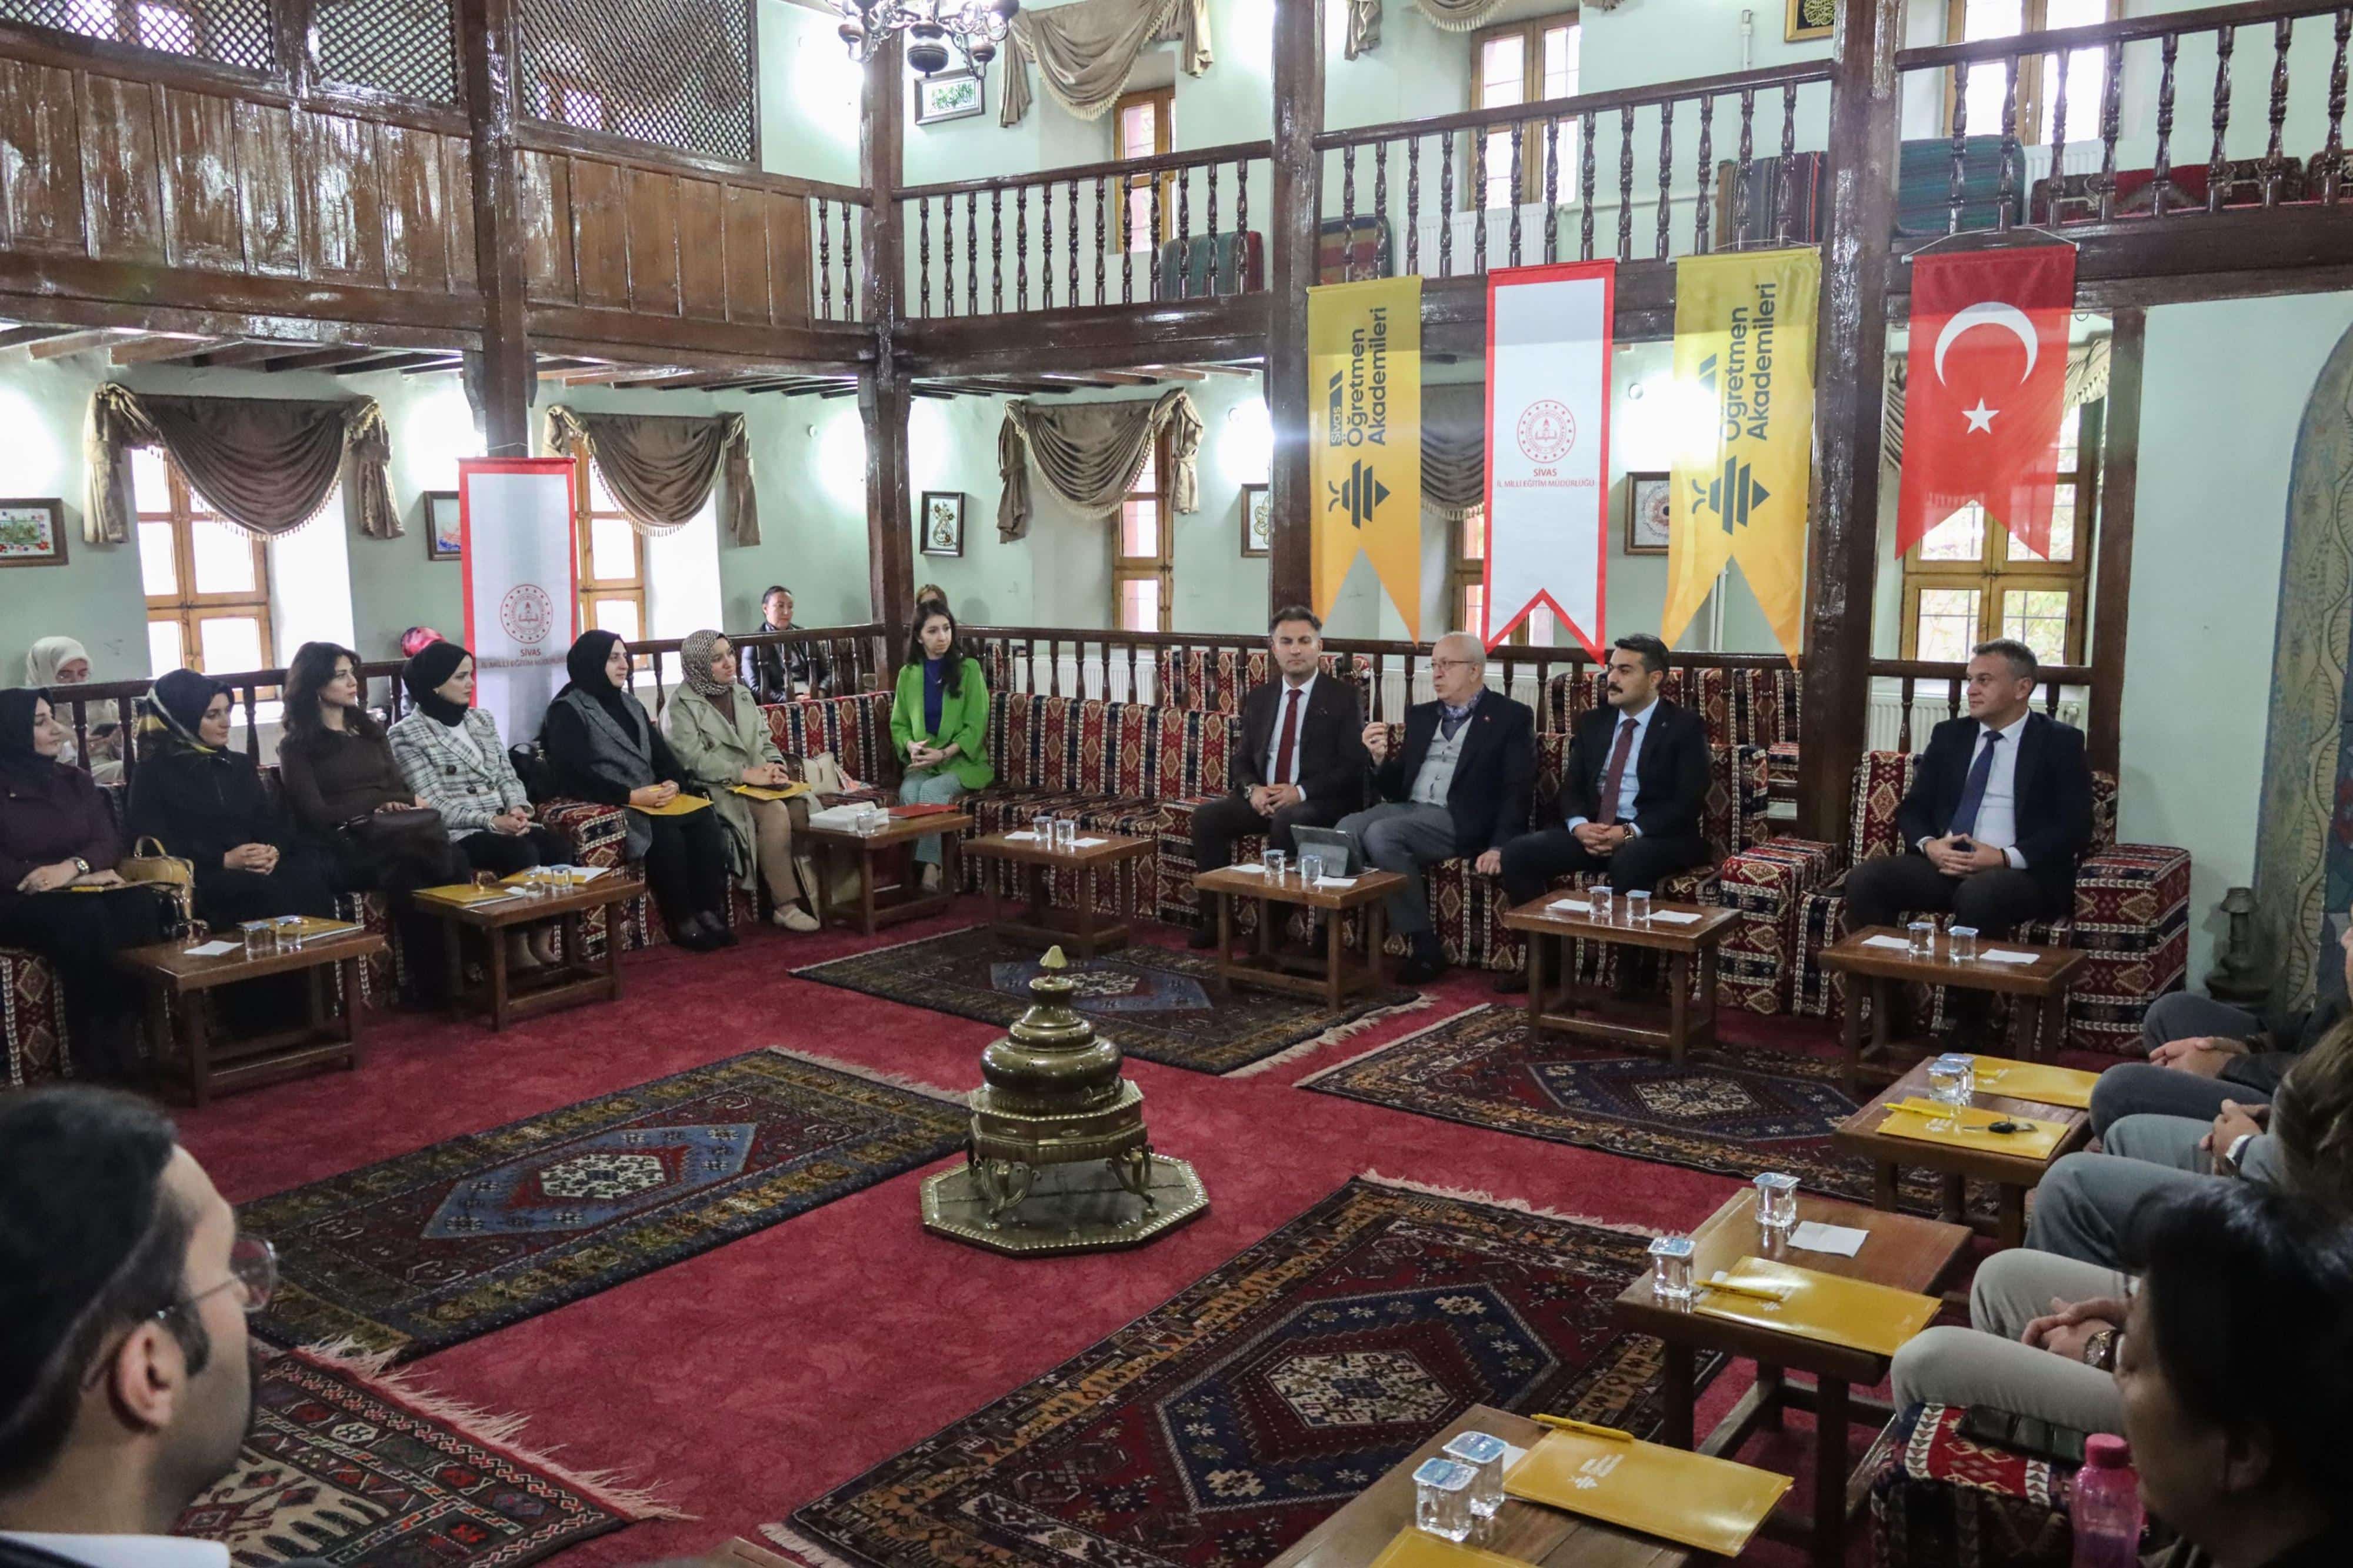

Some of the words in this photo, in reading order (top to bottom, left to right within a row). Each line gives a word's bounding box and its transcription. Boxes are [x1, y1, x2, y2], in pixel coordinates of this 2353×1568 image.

[1368, 307, 1387, 446] Akademileri
[1747, 283, 1777, 441] Akademileri
[1343, 329, 1368, 447] Öğretmen
[1331, 406, 1342, 444] Sivas
[1523, 479, 1547, 488] EĞİTİM
[1548, 476, 1595, 487] MÜDÜRLÜĞÜ
[1534, 467, 1557, 476] SİVAS
[521, 648, 541, 657] SİVAS
